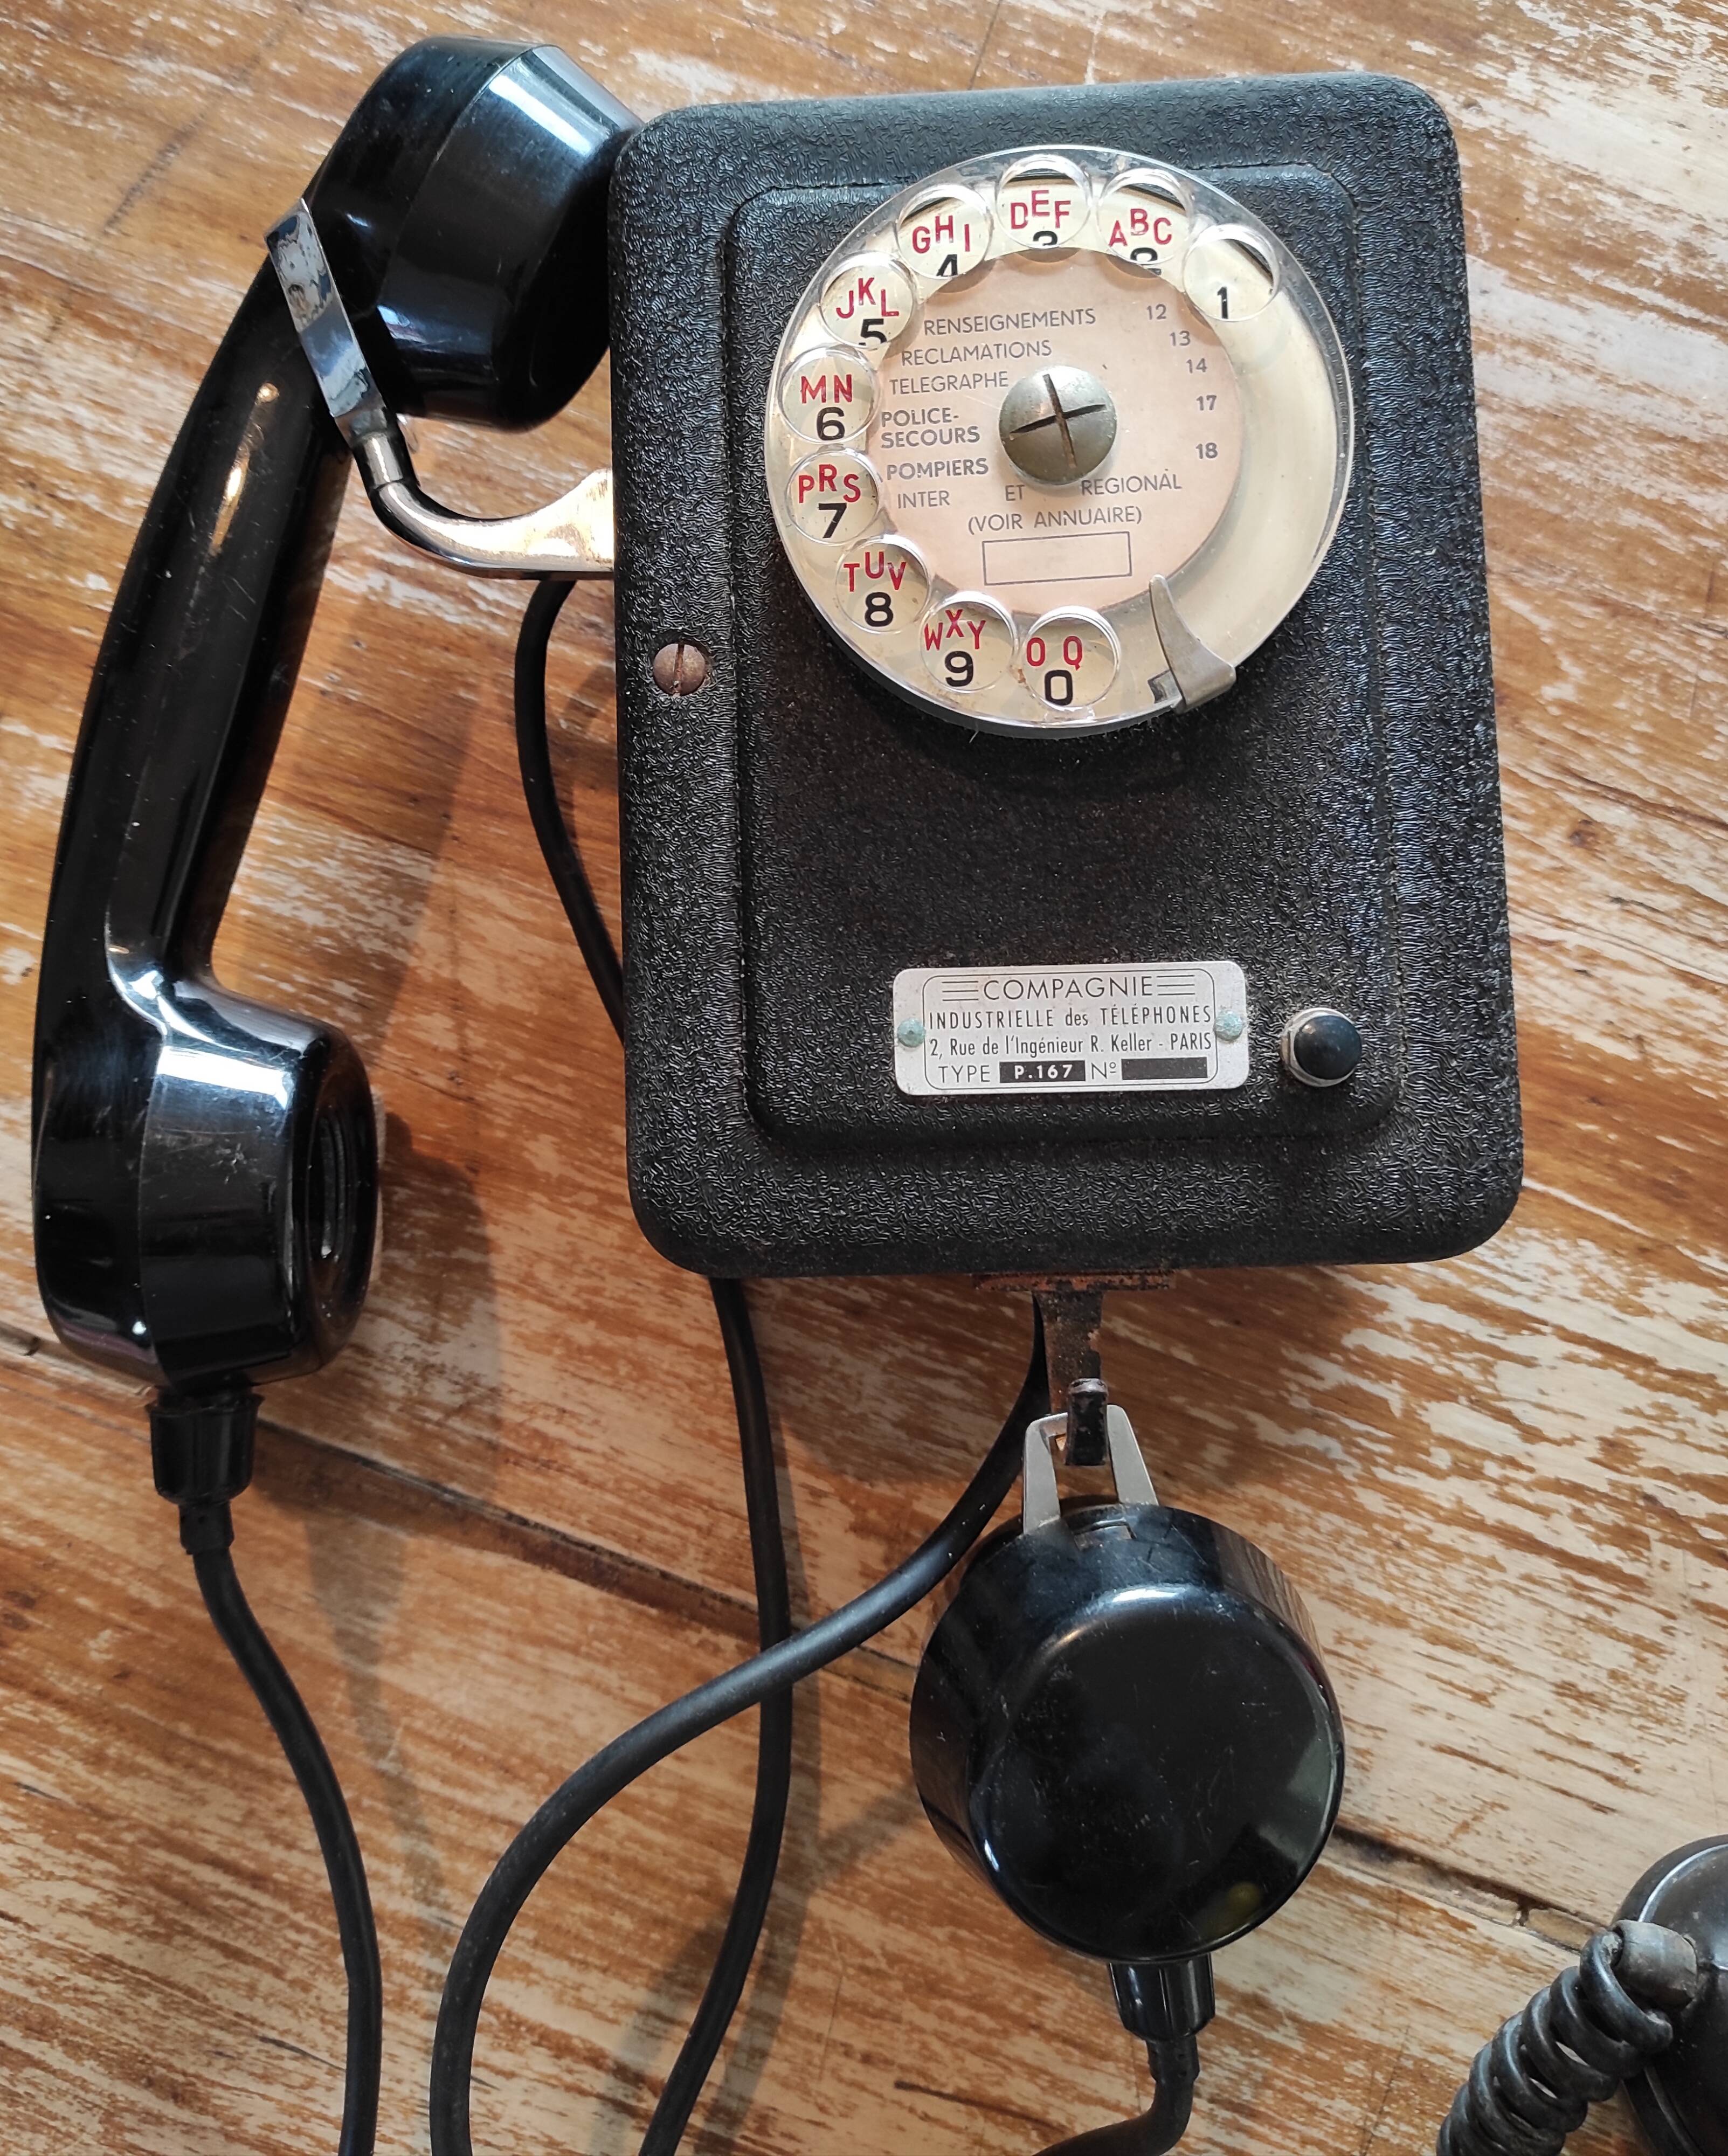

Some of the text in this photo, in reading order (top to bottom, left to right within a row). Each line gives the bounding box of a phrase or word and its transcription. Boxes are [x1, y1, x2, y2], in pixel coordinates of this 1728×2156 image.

[1011, 190, 1071, 230] DEF
[1109, 208, 1172, 247] ABC
[912, 215, 971, 253] GHI
[936, 254, 958, 277] 4
[836, 278, 899, 319] JKL
[1217, 286, 1228, 319] 1
[859, 319, 887, 346] 5
[924, 304, 1167, 335] RENSEIGNEMENTS 12
[902, 331, 1191, 366] RECLAMATIONS 13
[800, 374, 852, 403] MN
[889, 358, 1207, 395] TELEGRAPHE 14
[816, 406, 845, 440] 6
[881, 395, 1216, 427] POLICE- 17
[881, 426, 980, 448] SECOURS
[887, 443, 1218, 480] POMPIERS 18
[798, 464, 861, 503] PRS
[897, 473, 1182, 509] INTER ET REGIONAL
[818, 502, 847, 538] 7
[969, 506, 1142, 534] (VOIR ANNUAIRE)
[844, 551, 906, 592] TUV
[865, 592, 894, 627] 8
[924, 609, 986, 651] WXY
[944, 651, 974, 687] 9
[984, 976, 1152, 1000] COMPAGNIE
[930, 1003, 1211, 1029] INDUSTRIELLE des TÉLÉPHONES
[930, 1039, 943, 1059] 2,
[950, 1038, 975, 1056] Rue
[983, 1036, 998, 1055] de
[1091, 1035, 1104, 1052] R.
[1111, 1032, 1152, 1052] Keller
[1171, 1032, 1211, 1051] PARIS
[938, 1065, 991, 1083] TYPE
[1014, 1064, 1073, 1079] P.167
